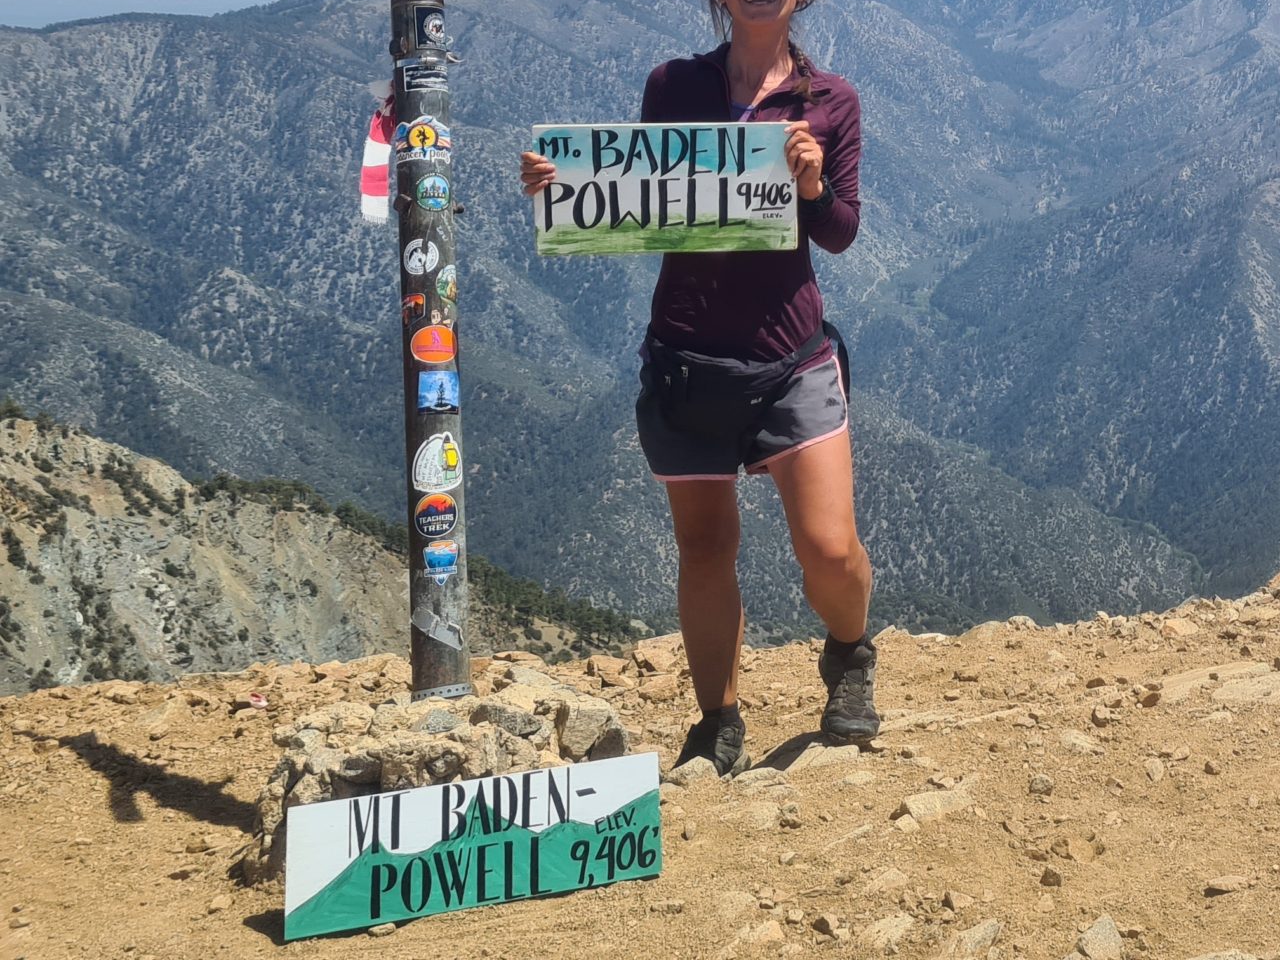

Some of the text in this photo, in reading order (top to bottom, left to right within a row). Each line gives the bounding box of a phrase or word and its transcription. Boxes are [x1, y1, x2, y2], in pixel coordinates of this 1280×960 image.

[539, 126, 767, 178] MT. BADEN-
[544, 177, 746, 233] POWELL
[424, 523, 450, 532] TREK
[348, 767, 596, 858] MT BADEN-
[594, 807, 637, 835] ELEV.
[370, 837, 552, 919] POWELL
